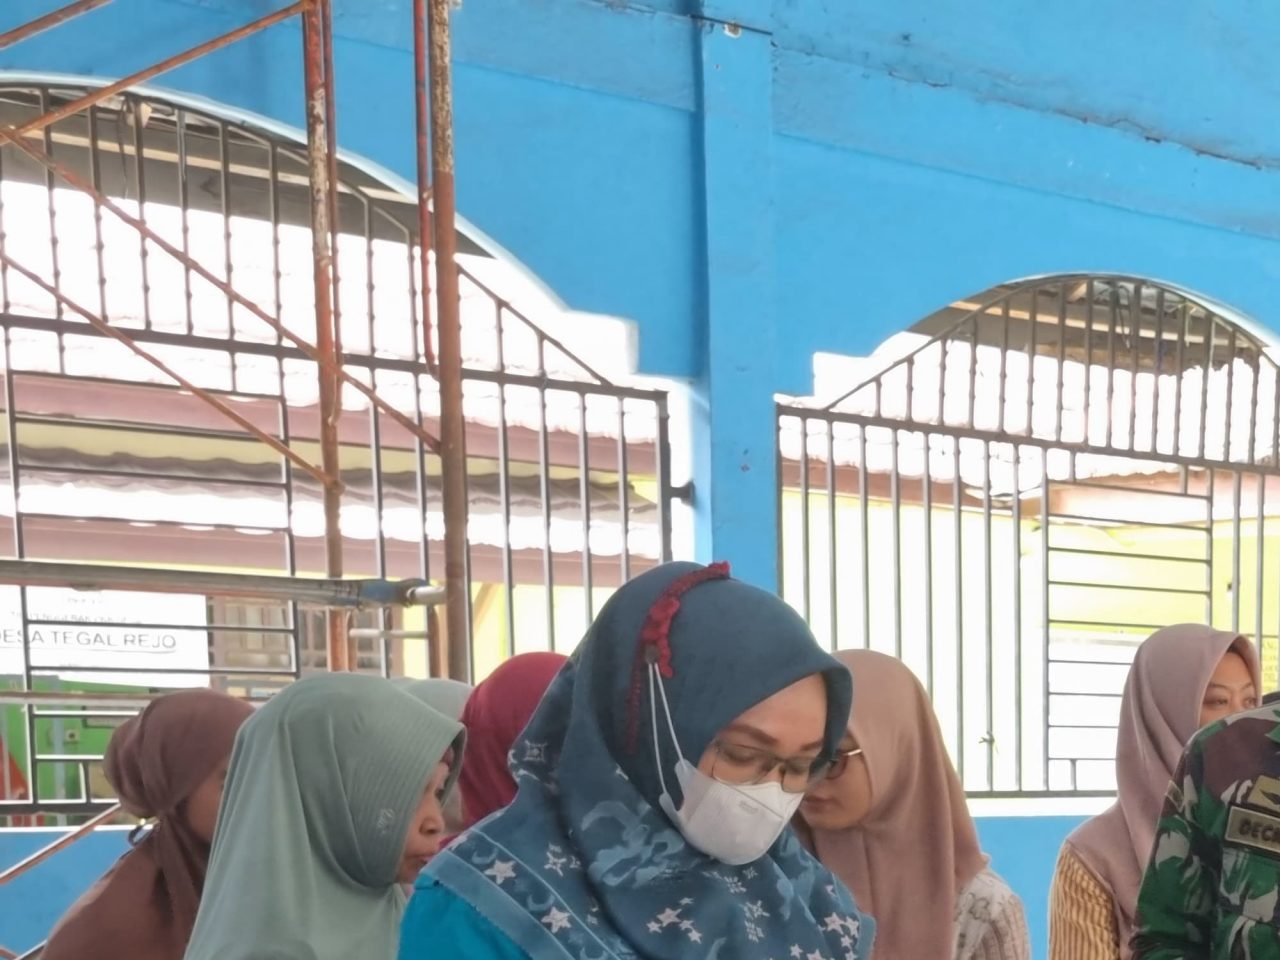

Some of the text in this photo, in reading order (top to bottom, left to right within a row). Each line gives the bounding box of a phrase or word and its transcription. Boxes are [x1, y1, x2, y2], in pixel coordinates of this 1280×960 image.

[0, 628, 177, 649] ESA TEGAL REJO
